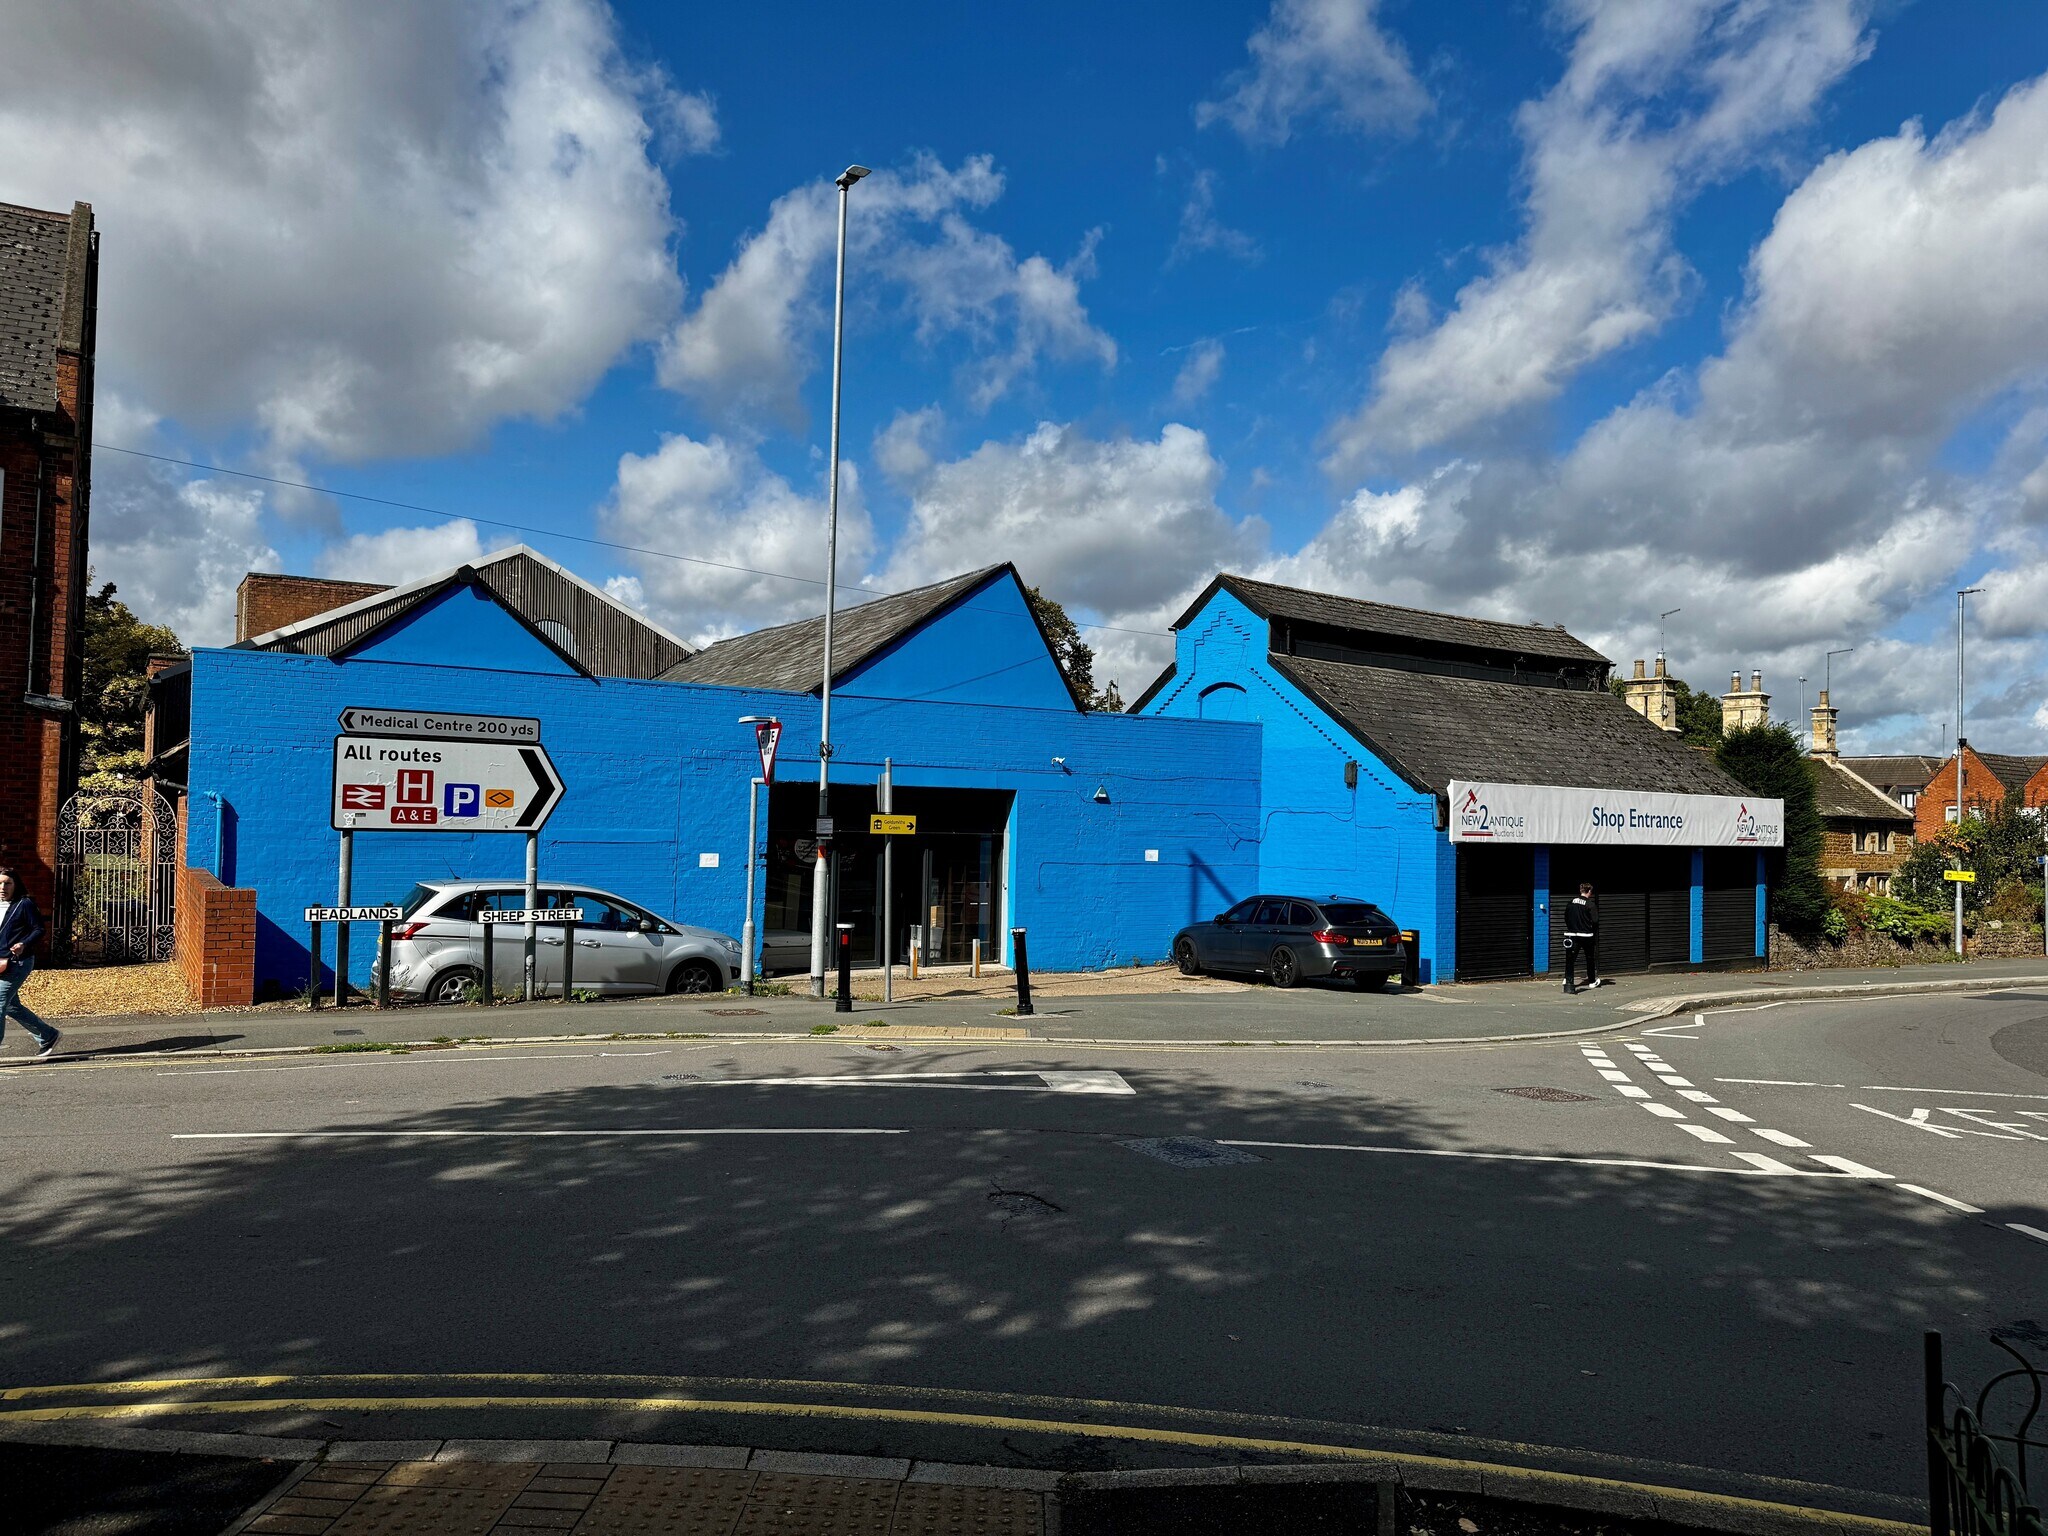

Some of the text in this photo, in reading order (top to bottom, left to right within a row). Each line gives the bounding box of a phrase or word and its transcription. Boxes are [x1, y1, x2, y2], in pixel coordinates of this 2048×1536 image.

[361, 714, 534, 736] Medical Centre 200 yds
[344, 745, 442, 763] All routes
[403, 772, 428, 801] H
[452, 787, 475, 814] P
[396, 810, 407, 821] A
[423, 810, 432, 821] E
[1592, 806, 1683, 833] Shop Entrance
[1494, 829, 1524, 838] Auctions Ltd
[309, 908, 399, 920] HEADLANDS
[482, 909, 579, 922] SHEEP STREET
